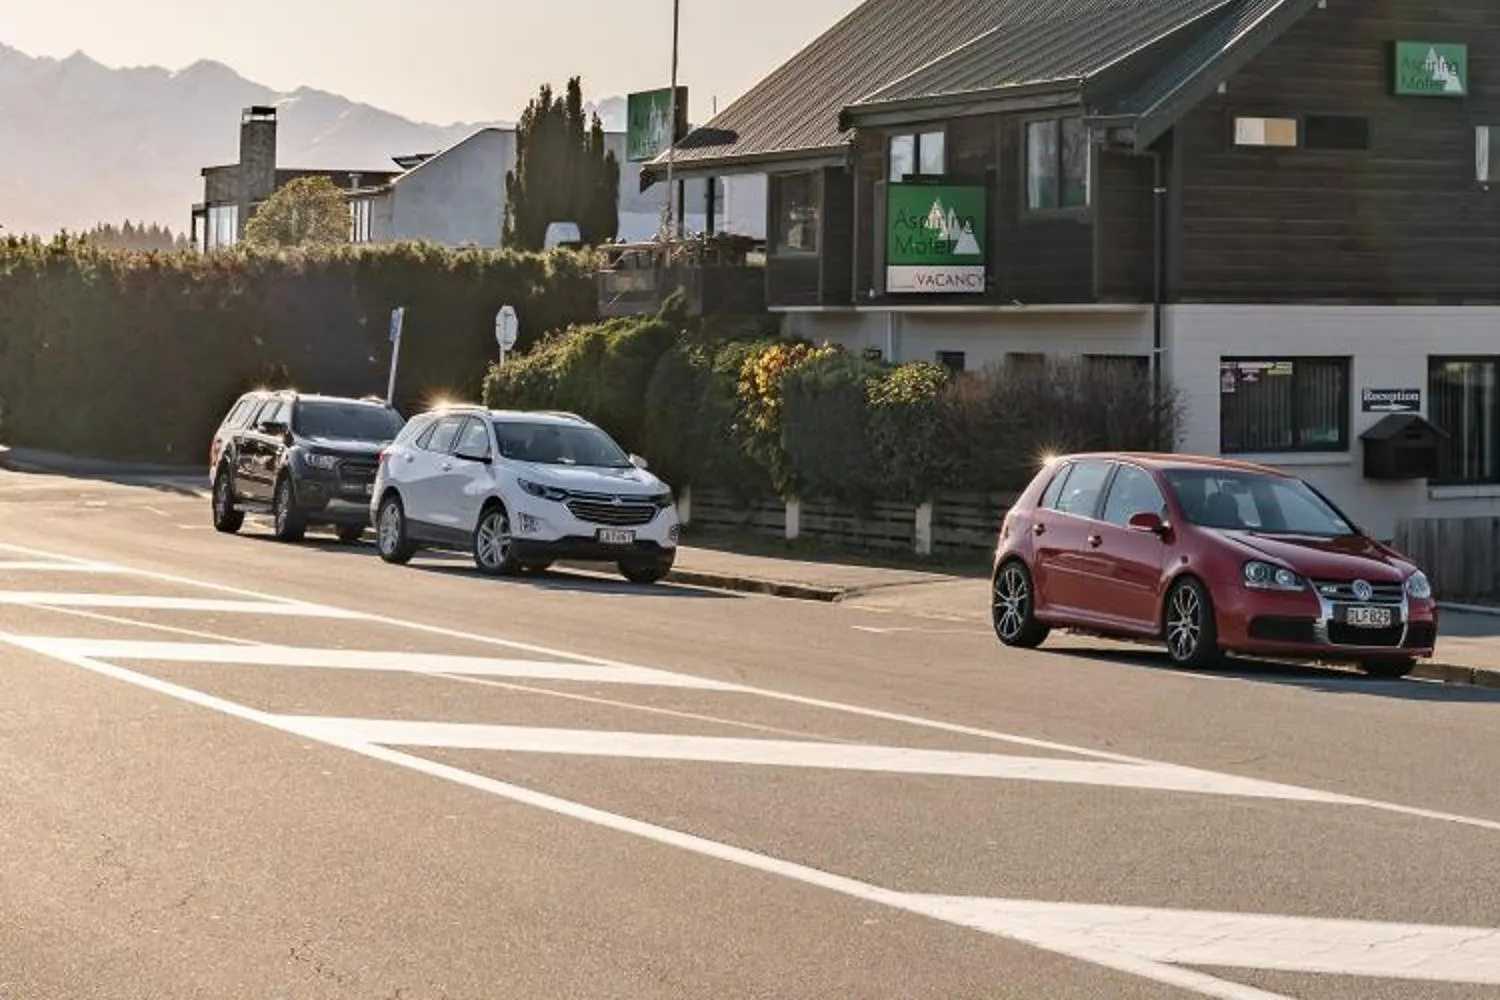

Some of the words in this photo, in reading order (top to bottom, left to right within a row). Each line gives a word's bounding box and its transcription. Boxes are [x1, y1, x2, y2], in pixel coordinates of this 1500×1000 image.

[893, 207, 975, 235] Aspiring
[893, 234, 953, 255] Motel
[1363, 390, 1419, 403] Reception
